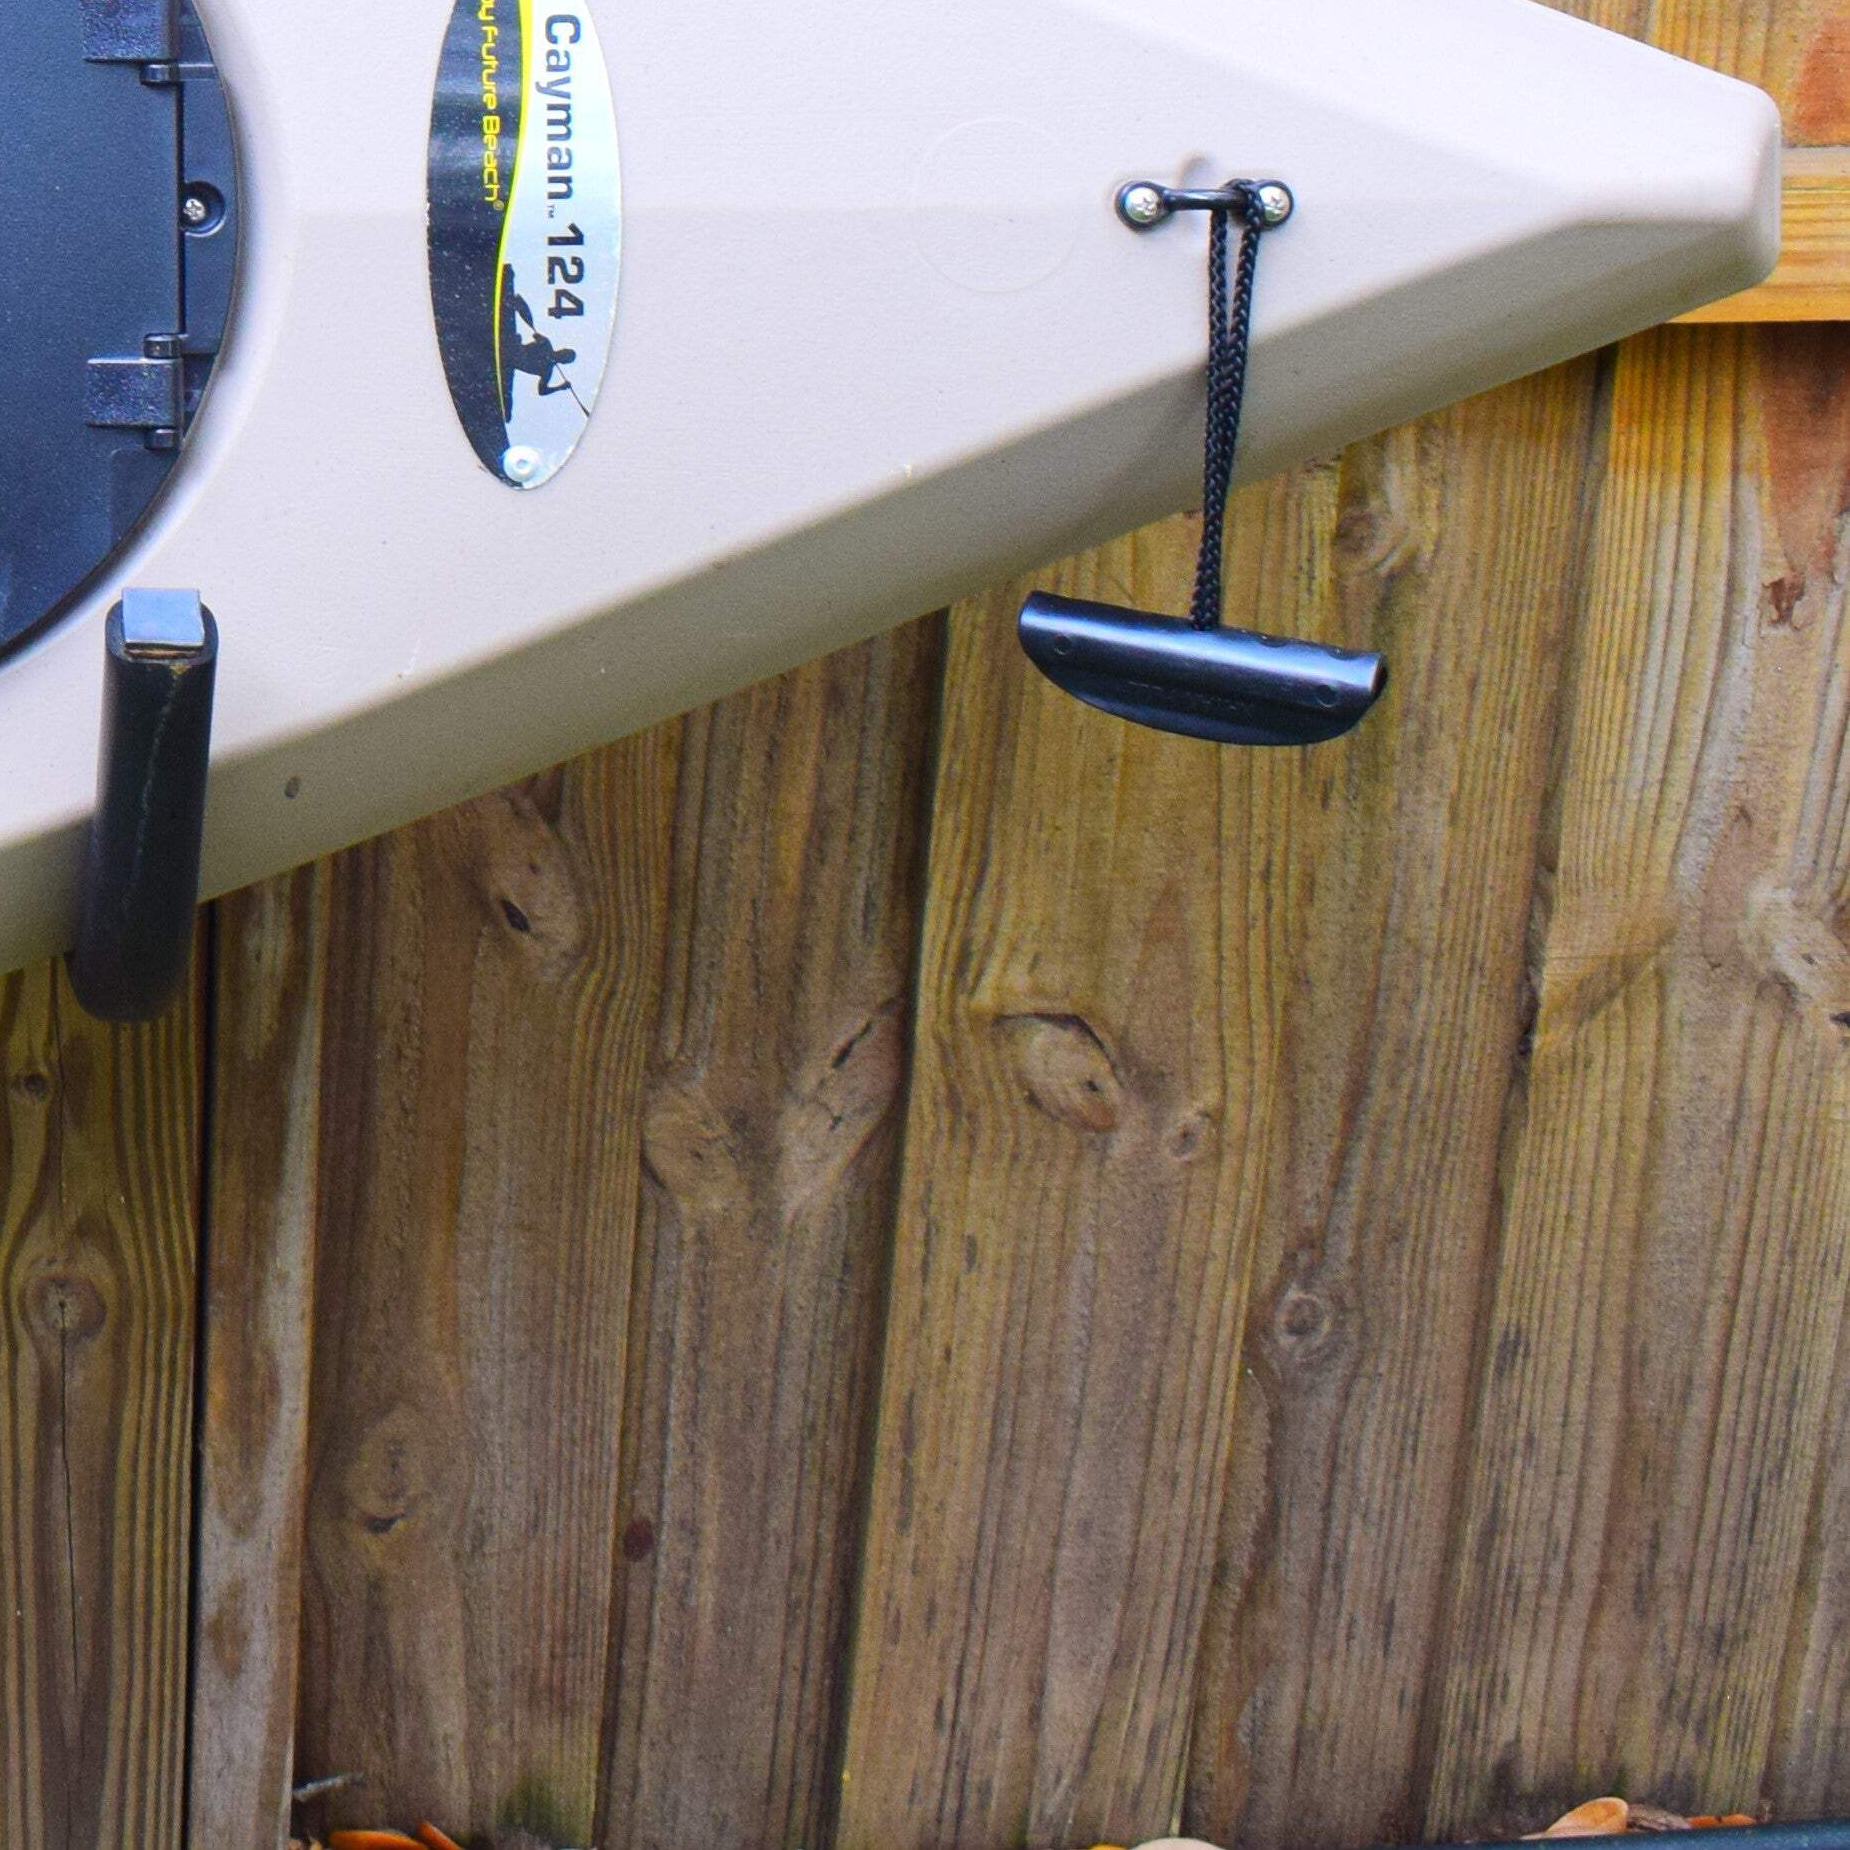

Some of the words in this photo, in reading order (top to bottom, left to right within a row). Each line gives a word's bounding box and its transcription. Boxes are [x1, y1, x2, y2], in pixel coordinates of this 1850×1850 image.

[481, 26, 499, 109] Future
[535, 13, 582, 200] Cayman
[548, 222, 585, 319] 124
